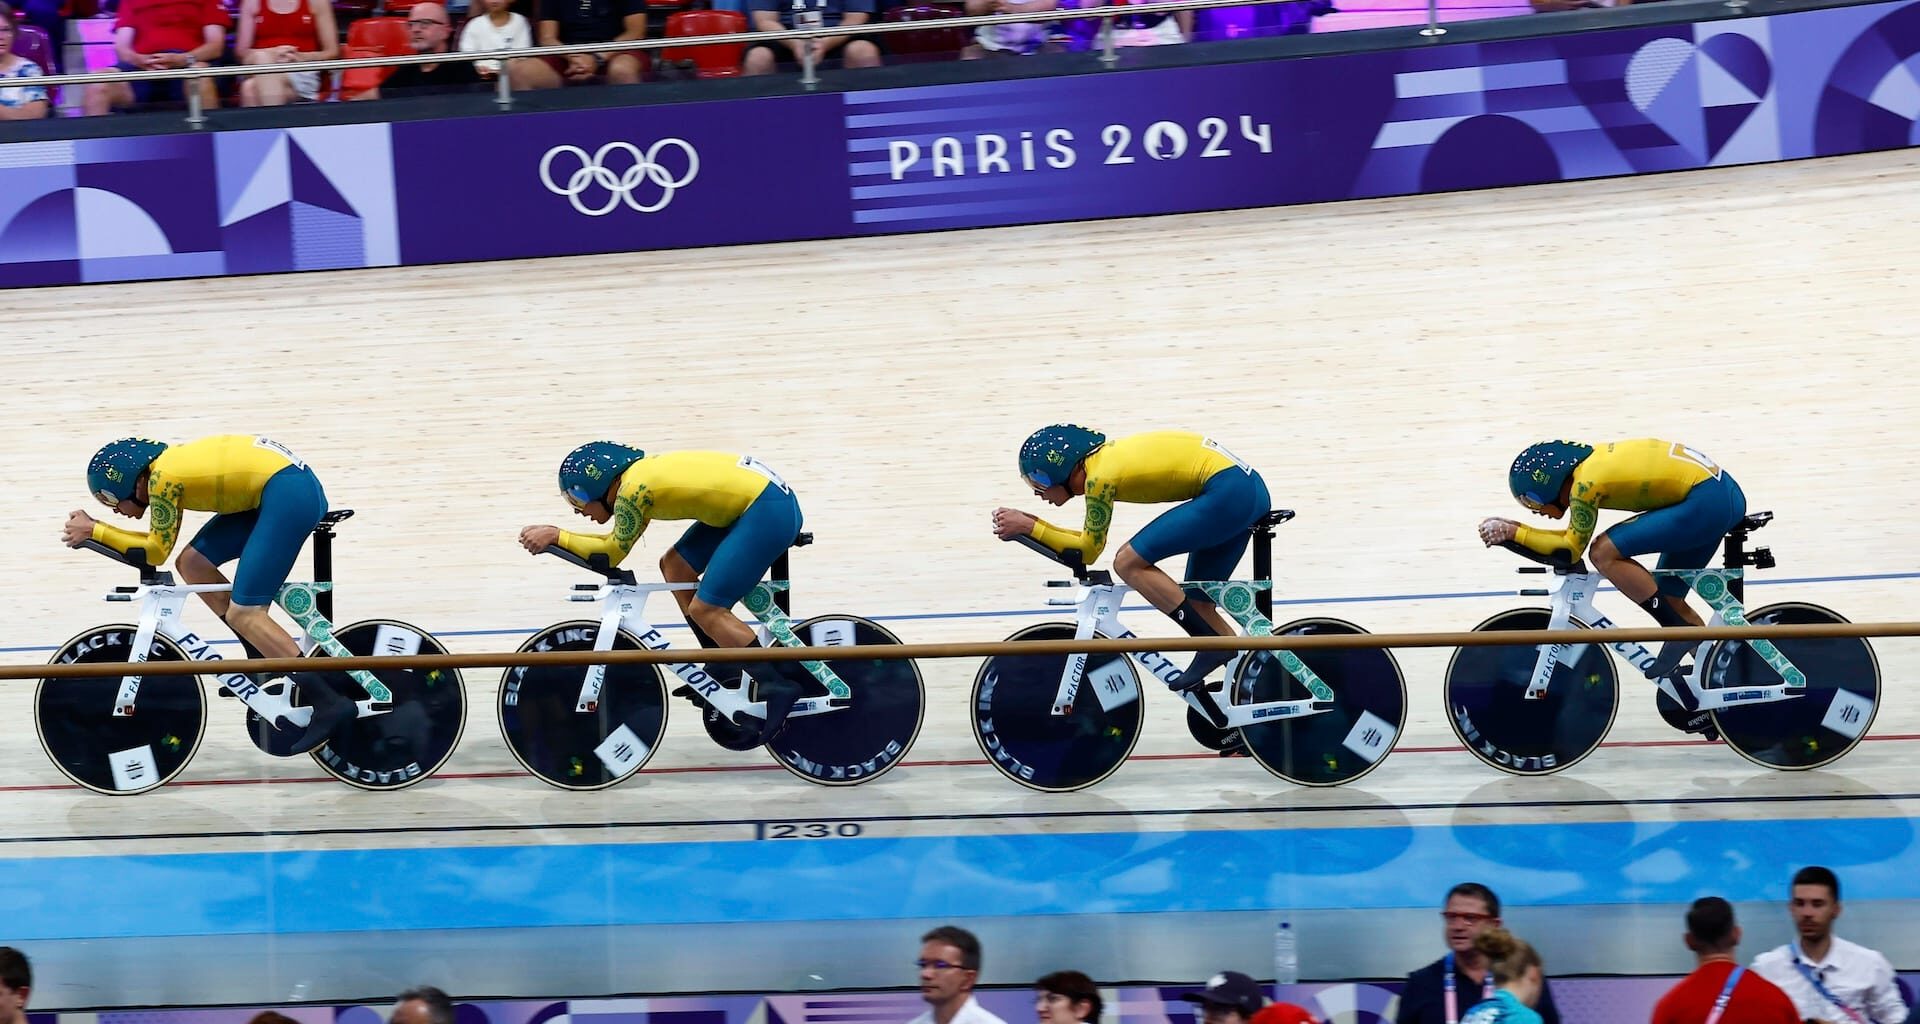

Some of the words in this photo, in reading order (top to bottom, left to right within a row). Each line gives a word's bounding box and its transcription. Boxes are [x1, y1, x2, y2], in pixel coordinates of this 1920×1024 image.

[1101, 115, 1273, 166] 2024
[57, 632, 122, 665] LACK
[639, 628, 721, 698] FATOR
[505, 636, 554, 706] BLAK
[555, 628, 595, 646] INC
[1067, 655, 1086, 697] FACTOR
[319, 744, 342, 767] IN
[783, 749, 823, 777] INC
[829, 739, 901, 779] BLACK
[979, 717, 1035, 780] BLACK
[1480, 740, 1557, 769] BLACK
[342, 761, 421, 784] BLACK
[770, 822, 862, 839] 230
